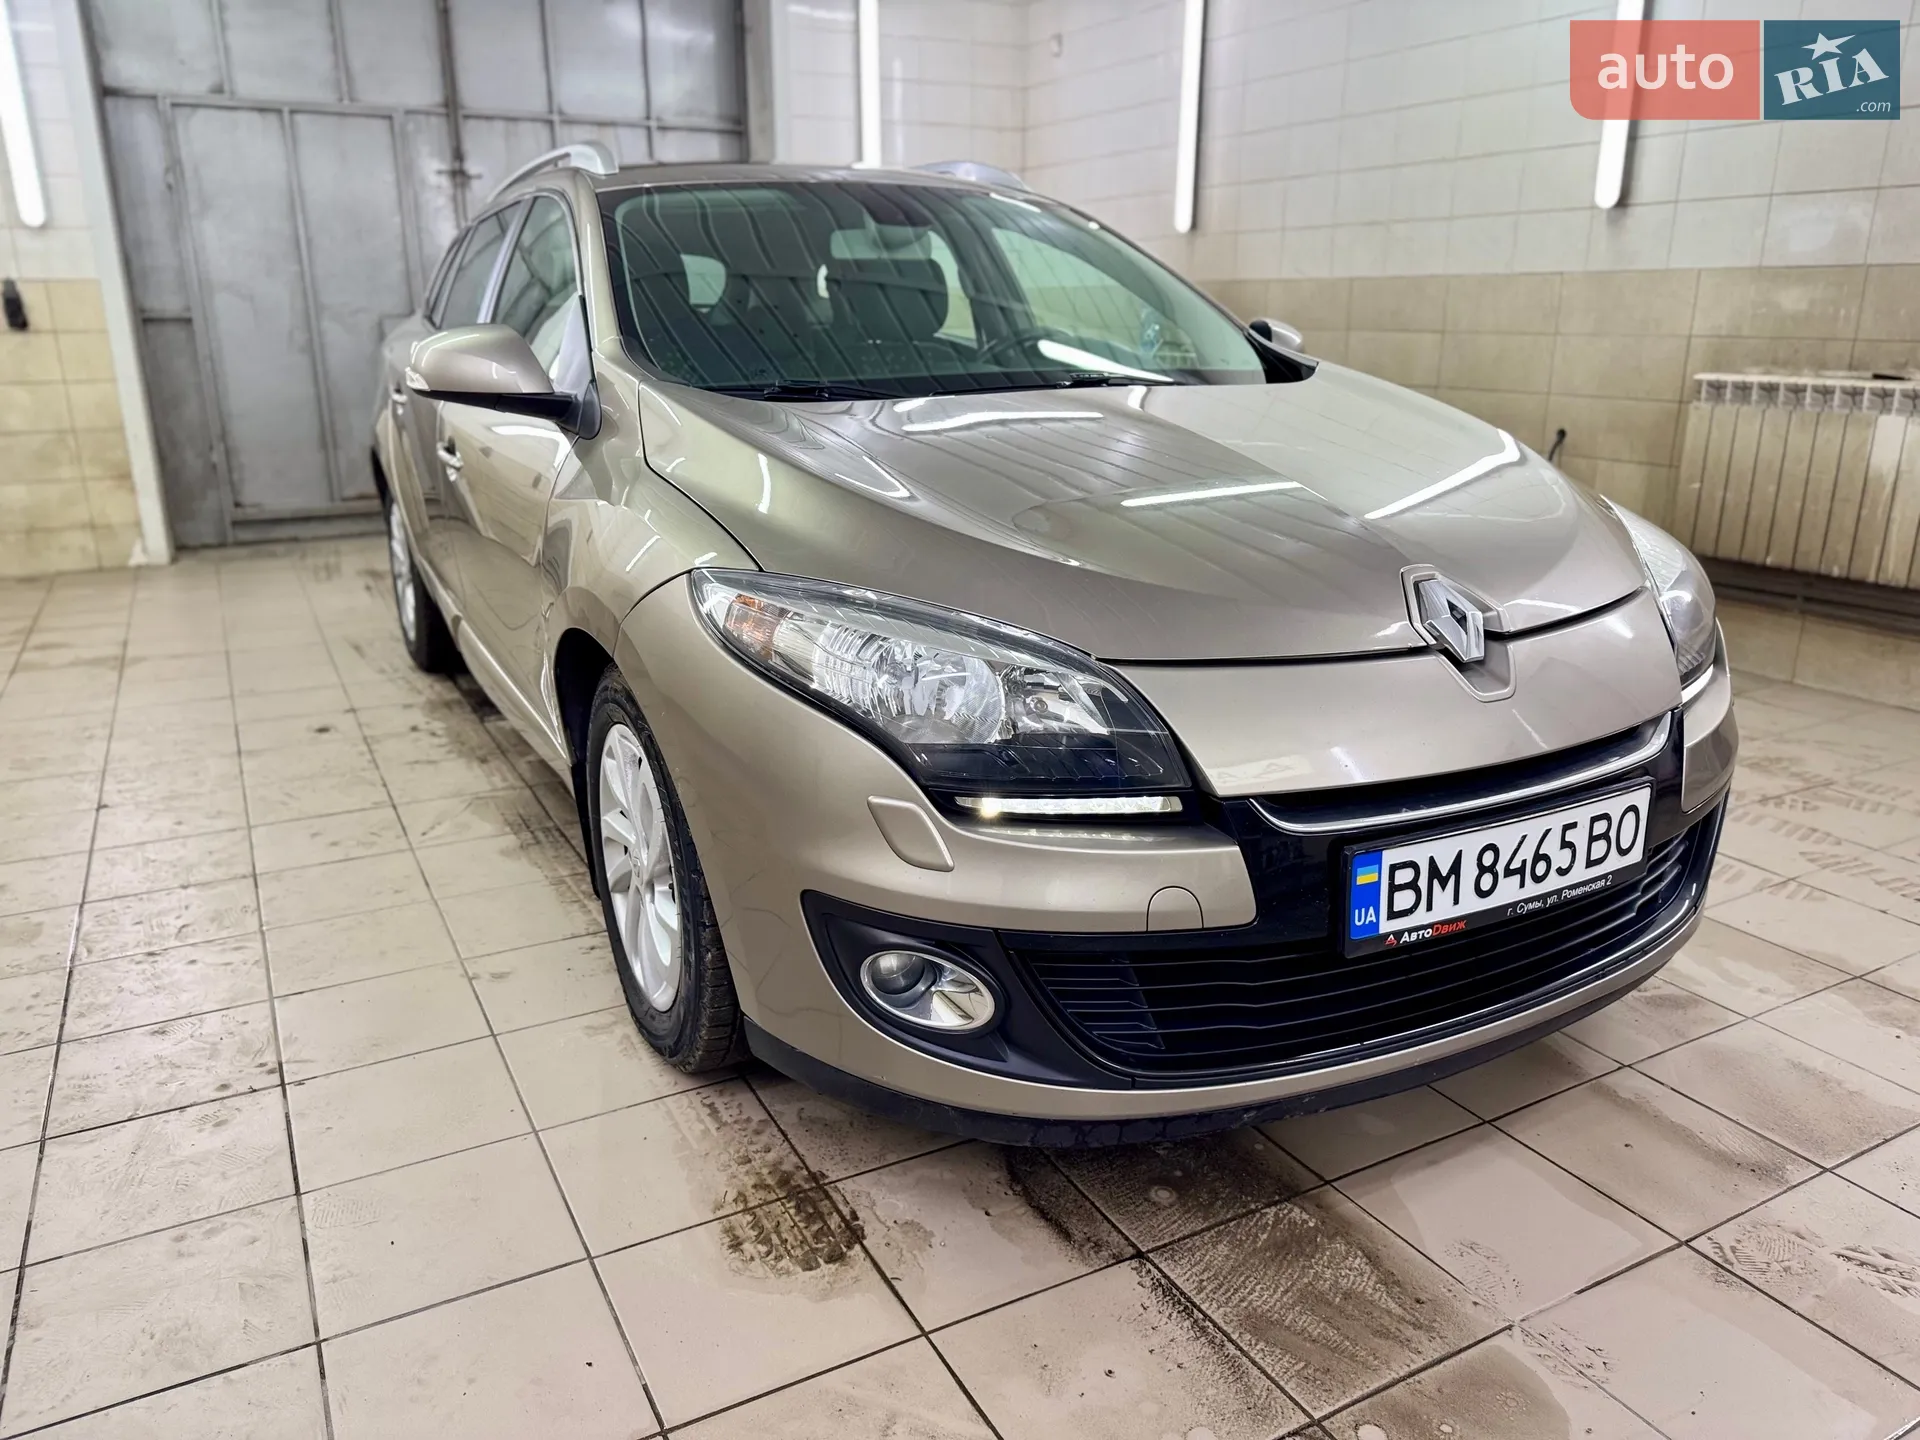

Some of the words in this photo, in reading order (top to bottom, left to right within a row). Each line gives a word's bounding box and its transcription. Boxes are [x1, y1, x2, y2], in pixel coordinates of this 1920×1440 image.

[1386, 849, 1463, 921] BM
[1474, 821, 1578, 899] 8465
[1516, 899, 1544, 915] Сумы,
[1546, 894, 1559, 908] ул.
[1561, 879, 1605, 900] Роменская
[1606, 874, 1613, 886] 2
[1354, 908, 1377, 926] UA
